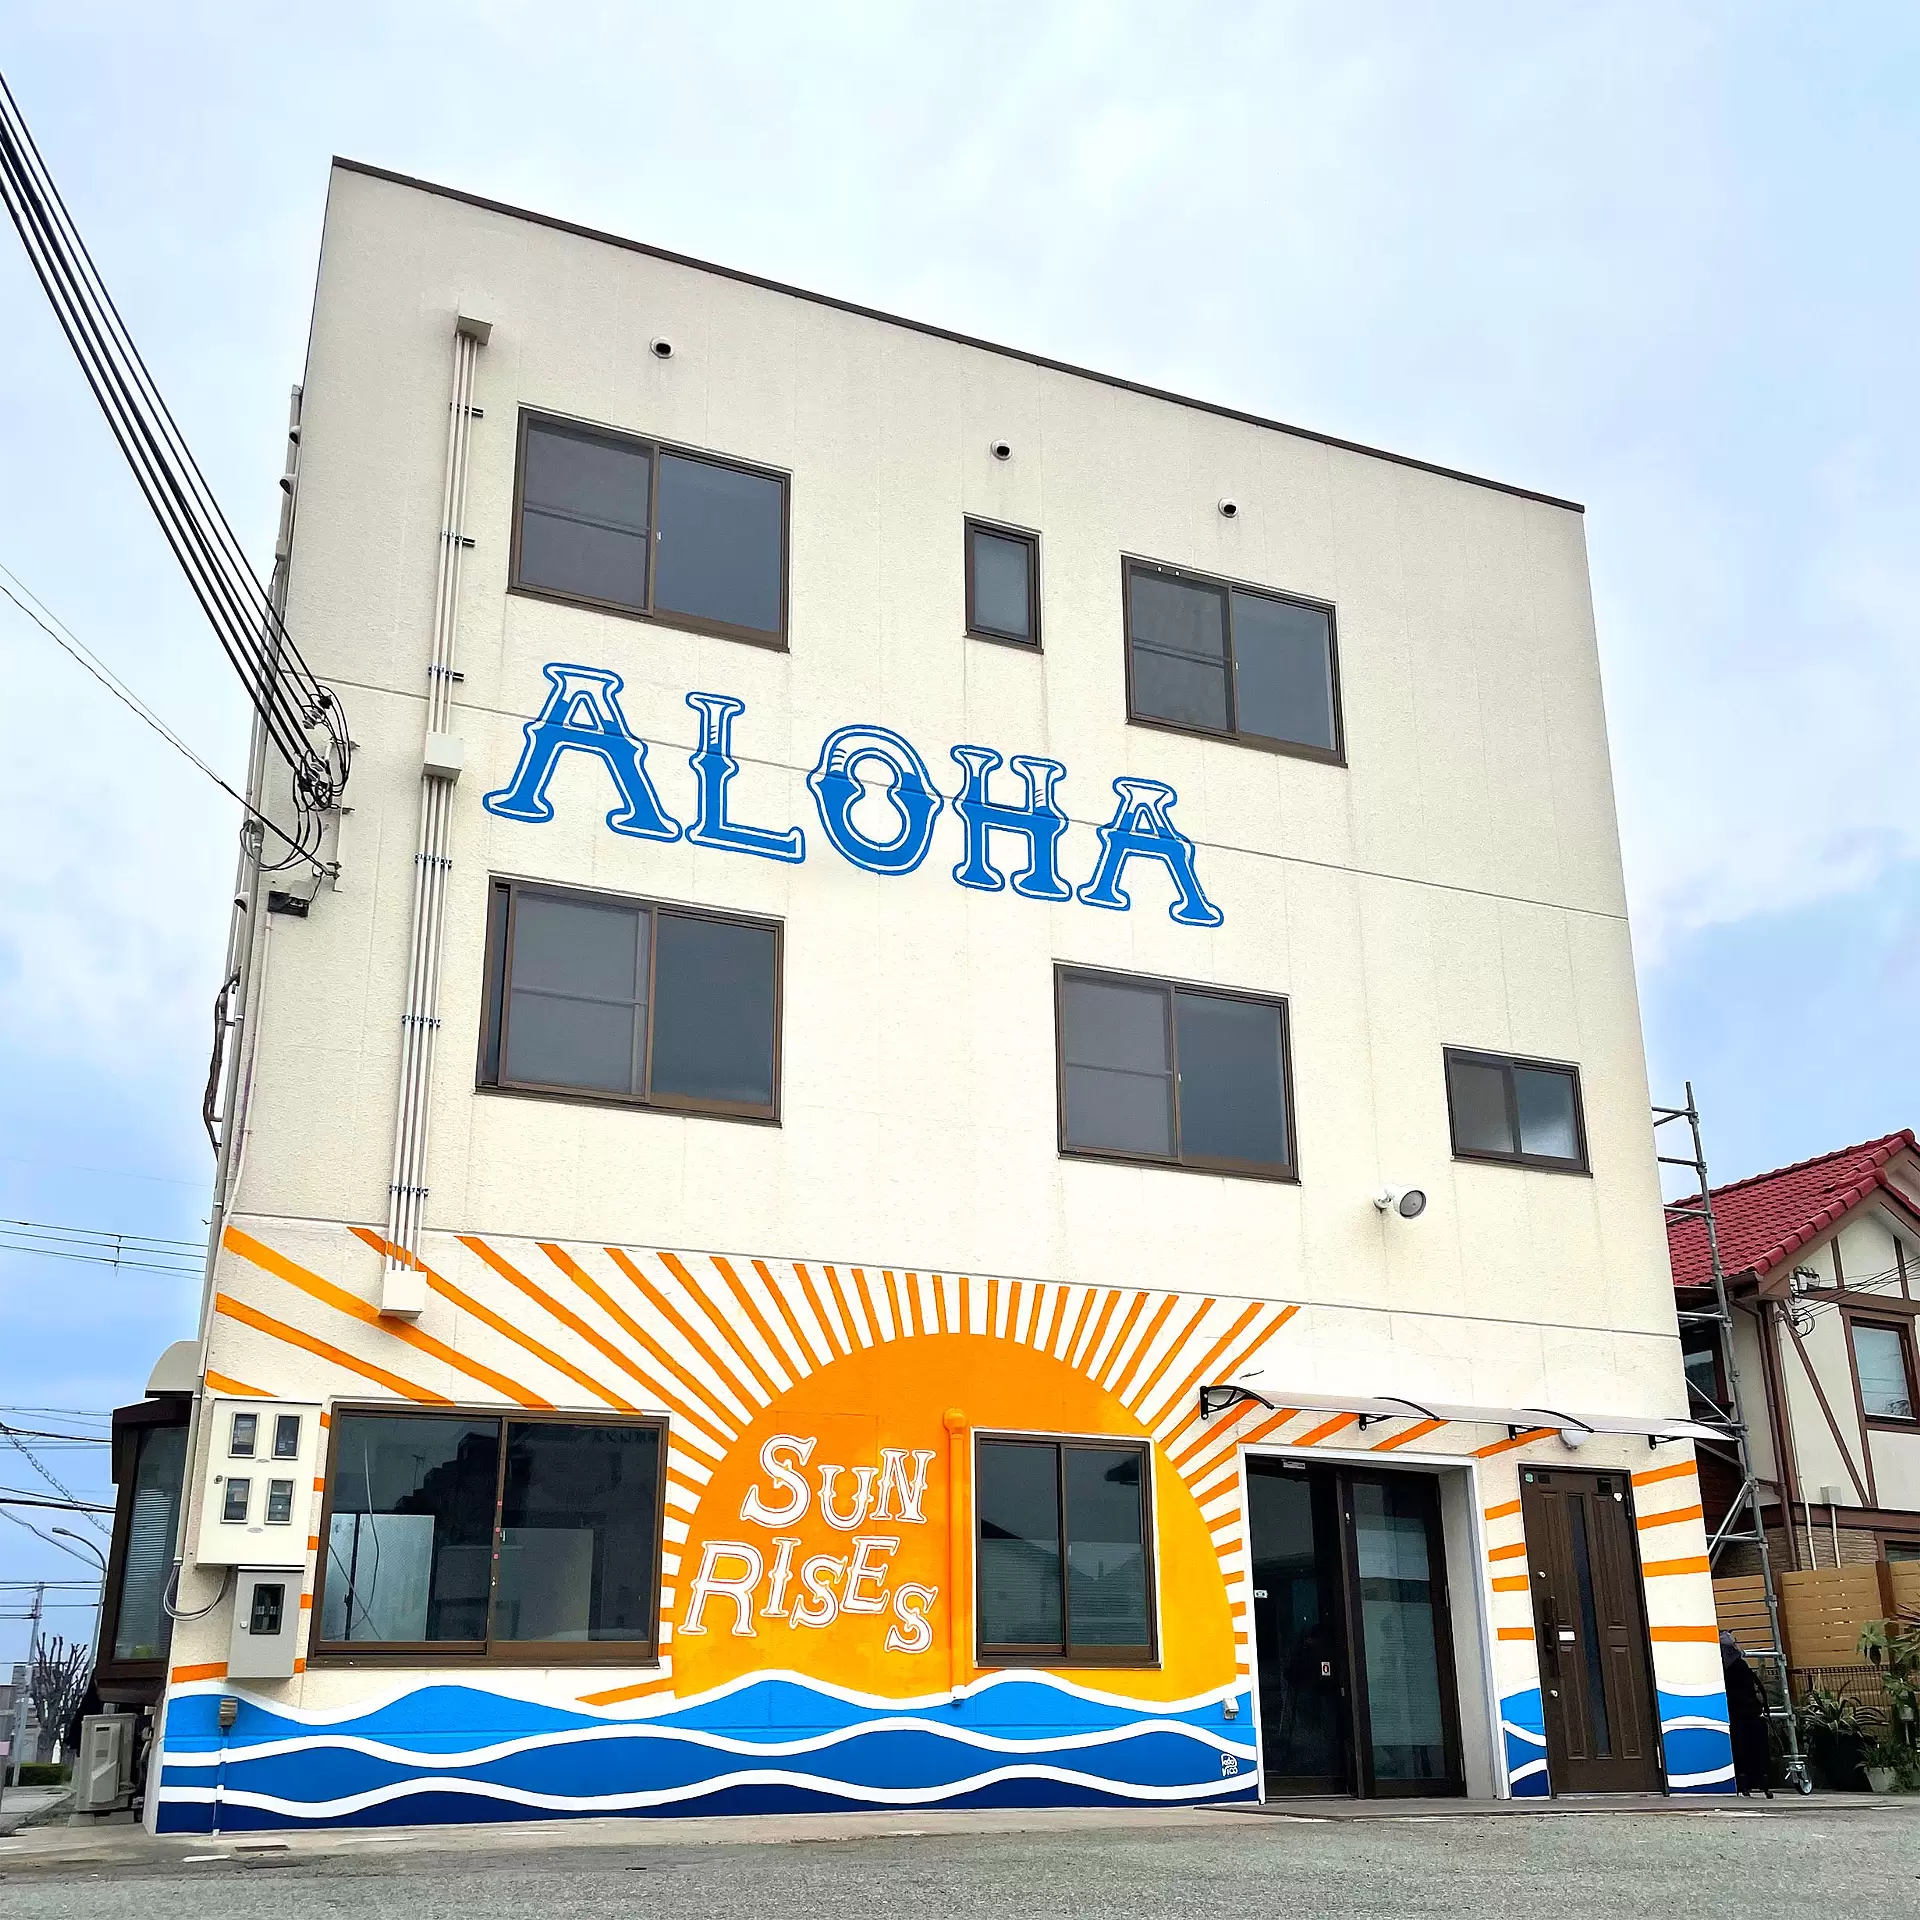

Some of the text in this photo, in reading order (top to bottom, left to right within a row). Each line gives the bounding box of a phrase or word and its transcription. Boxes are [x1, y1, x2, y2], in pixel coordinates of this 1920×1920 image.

[483, 662, 1224, 928] ALOHA
[740, 1434, 936, 1530] SUN
[678, 1536, 939, 1653] RISES
